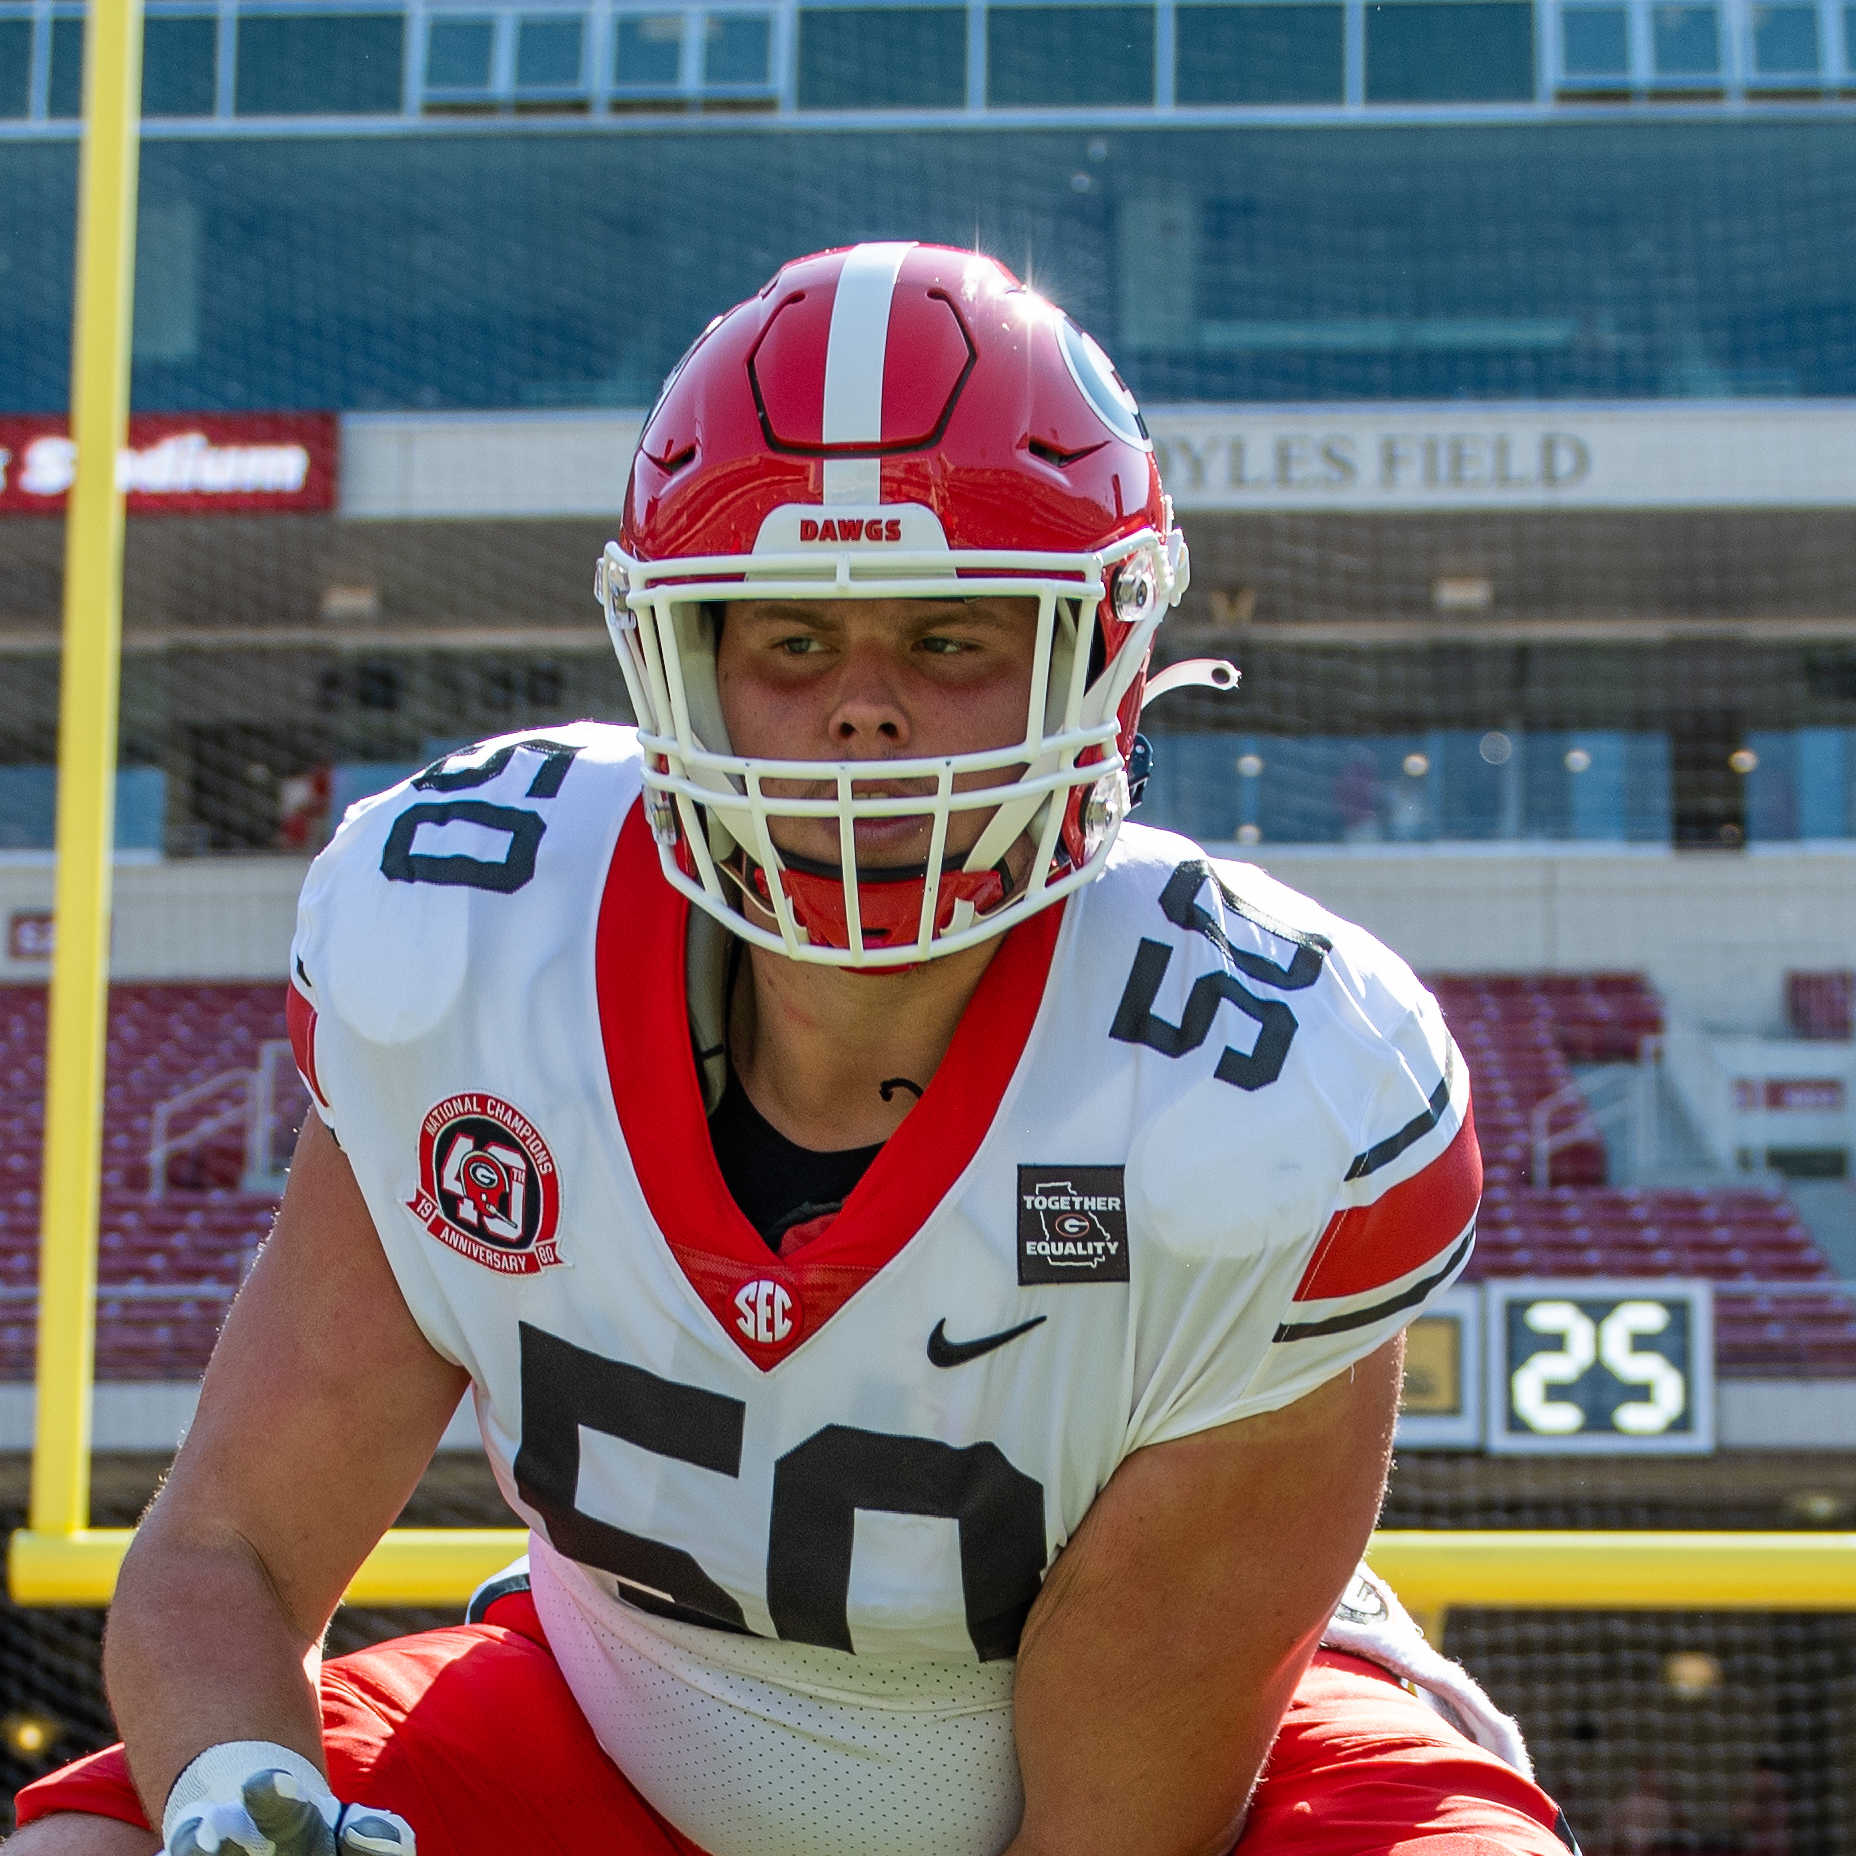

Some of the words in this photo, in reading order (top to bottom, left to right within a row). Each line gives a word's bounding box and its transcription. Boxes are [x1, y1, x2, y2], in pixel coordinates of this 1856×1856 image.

[1378, 430, 1590, 489] FIELD
[799, 519, 902, 542] DAWGS
[380, 739, 588, 894] 50
[1109, 859, 1334, 1092] 50
[424, 1096, 482, 1138] NATIONAL
[486, 1098, 554, 1176] CHAMPIONS
[416, 1198, 433, 1219] 19
[1023, 1196, 1121, 1211] TOGETHER
[439, 1226, 527, 1273] ANNIVERSARY
[1026, 1241, 1119, 1256] EQUALITY
[734, 1279, 793, 1343] SEC
[1511, 1300, 1685, 1436] 25
[513, 1320, 1047, 1664] 50
